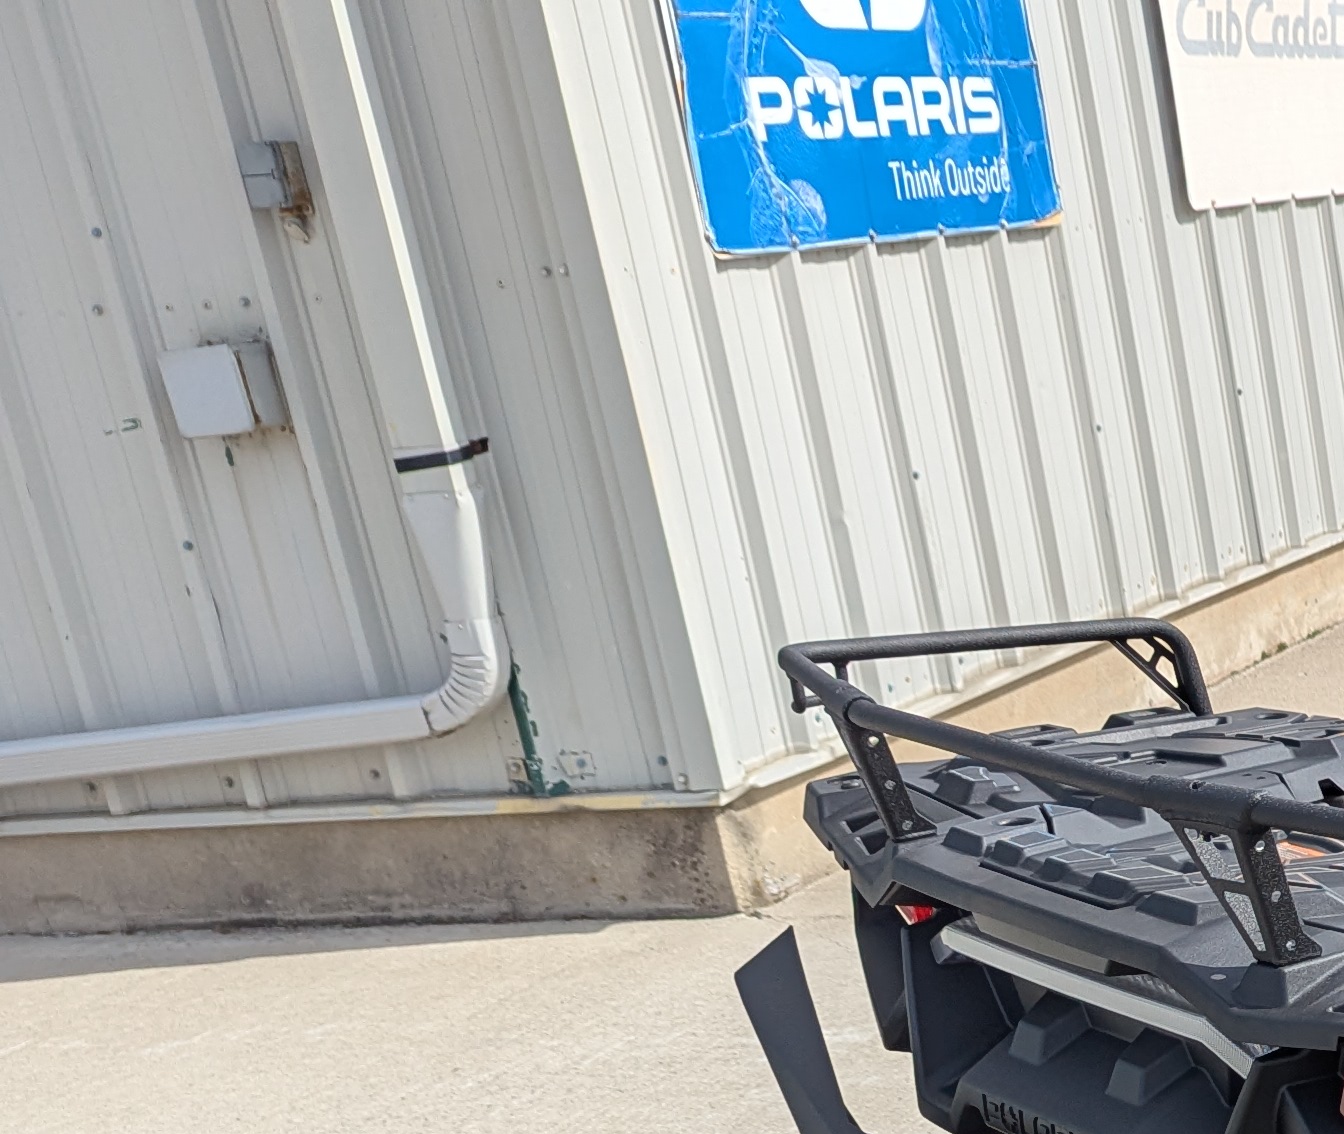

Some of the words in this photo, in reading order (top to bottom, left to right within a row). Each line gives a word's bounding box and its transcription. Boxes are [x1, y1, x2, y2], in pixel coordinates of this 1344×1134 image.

[1175, 0, 1243, 59] Cub
[747, 75, 1001, 142] POLARIS
[887, 156, 945, 201] Think
[945, 157, 1011, 197] Outside
